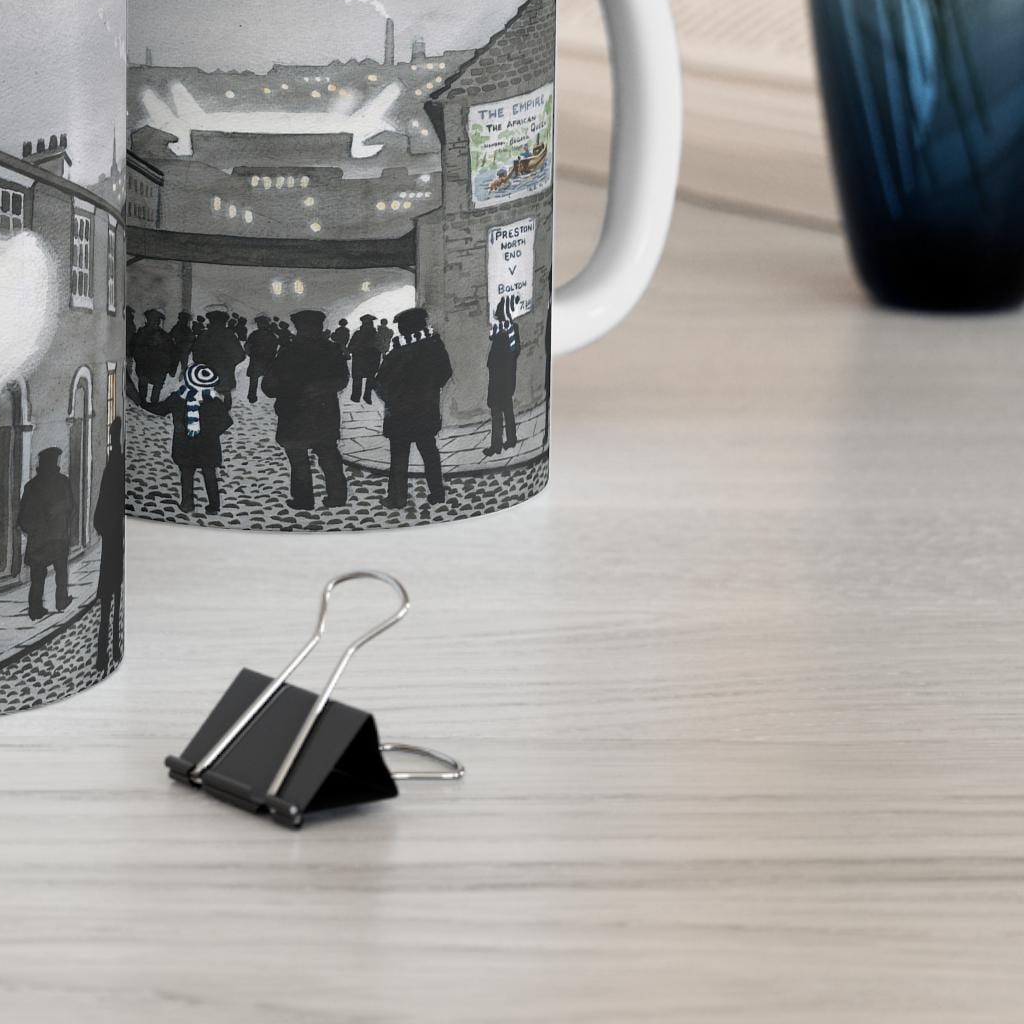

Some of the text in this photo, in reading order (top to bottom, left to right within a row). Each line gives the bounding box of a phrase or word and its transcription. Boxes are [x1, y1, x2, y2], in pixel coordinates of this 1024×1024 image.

[478, 94, 544, 120] THE EMPIRE
[486, 115, 536, 133] THE AFRICAN
[495, 225, 533, 240] PRESTON
[500, 239, 526, 250] NORTH
[504, 250, 522, 261] END
[498, 280, 527, 294] BOLTON
